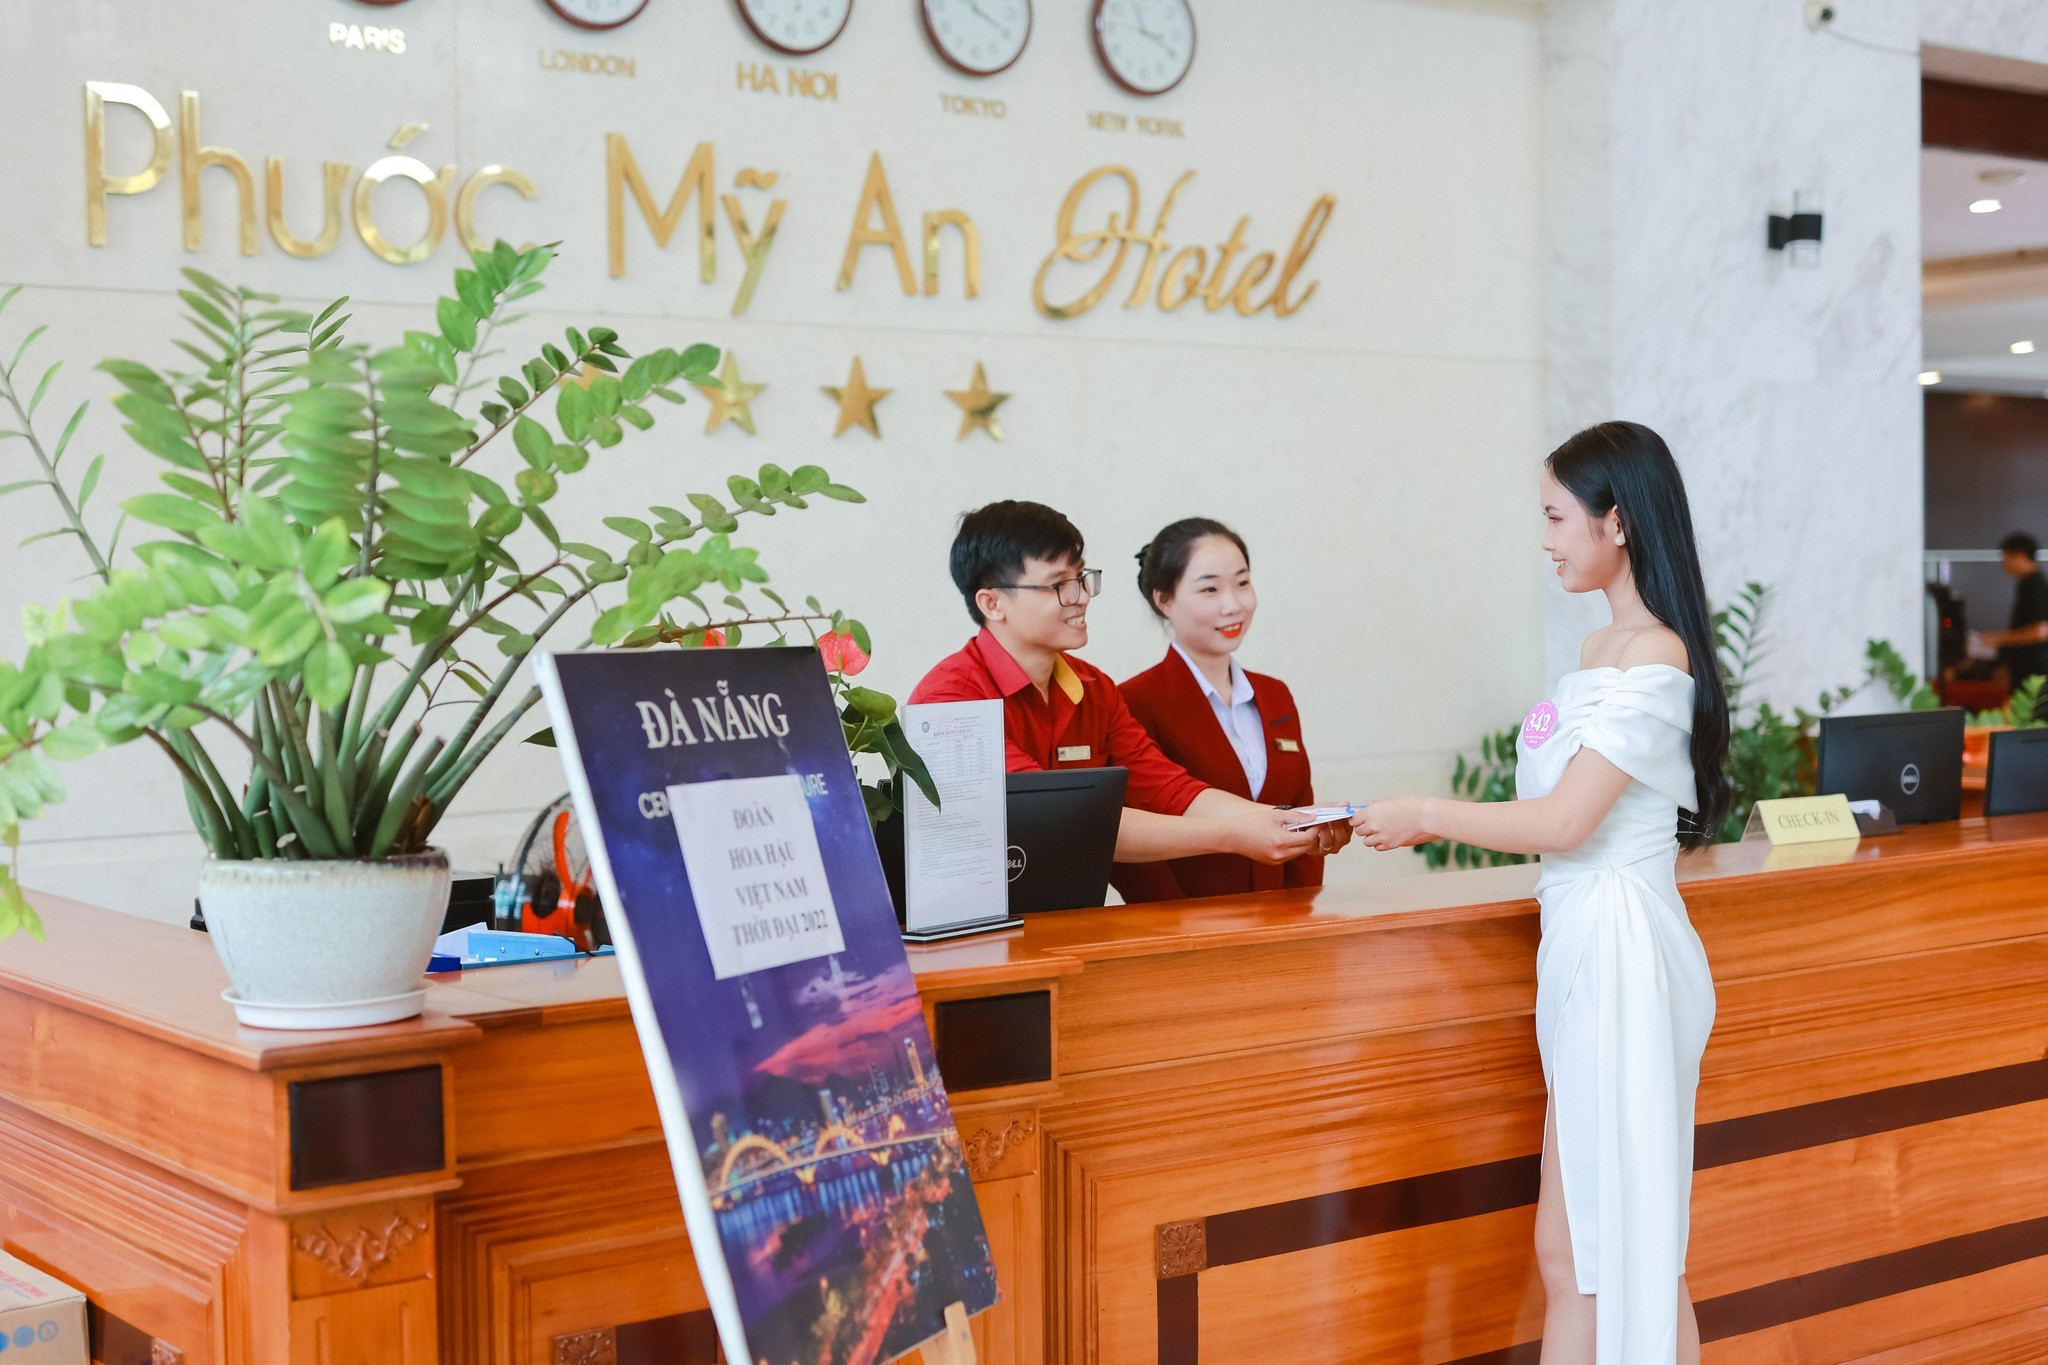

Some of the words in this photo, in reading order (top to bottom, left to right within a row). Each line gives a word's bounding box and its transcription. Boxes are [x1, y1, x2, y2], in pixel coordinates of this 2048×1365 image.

[329, 22, 407, 55] PARIS
[539, 48, 636, 78] LONDON
[736, 62, 779, 94] HA
[788, 66, 838, 102] NOI
[939, 92, 1007, 119] TOKYO
[1088, 110, 1130, 133] NEW
[1136, 115, 1185, 138] YORK
[83, 80, 538, 265] Phước
[606, 131, 789, 316] Mỹ
[836, 150, 981, 299] An
[1033, 164, 1337, 321] Hotel
[635, 687, 699, 749] ĐÀ
[691, 679, 790, 743] NẴNG
[1525, 712, 1552, 732] 342
[637, 791, 670, 820] CEN
[801, 773, 829, 797] URE
[732, 801, 775, 830] ĐOÀN
[1778, 809, 1841, 830] CHECK-IN
[728, 845, 763, 870] HOA
[764, 838, 795, 868] HẬU
[1007, 859, 1022, 869] ELL
[735, 879, 772, 910] VIỆT
[773, 876, 809, 901] NAM
[731, 914, 773, 947] THỜI
[772, 913, 800, 941] ĐẠI
[800, 908, 828, 932] 2022
